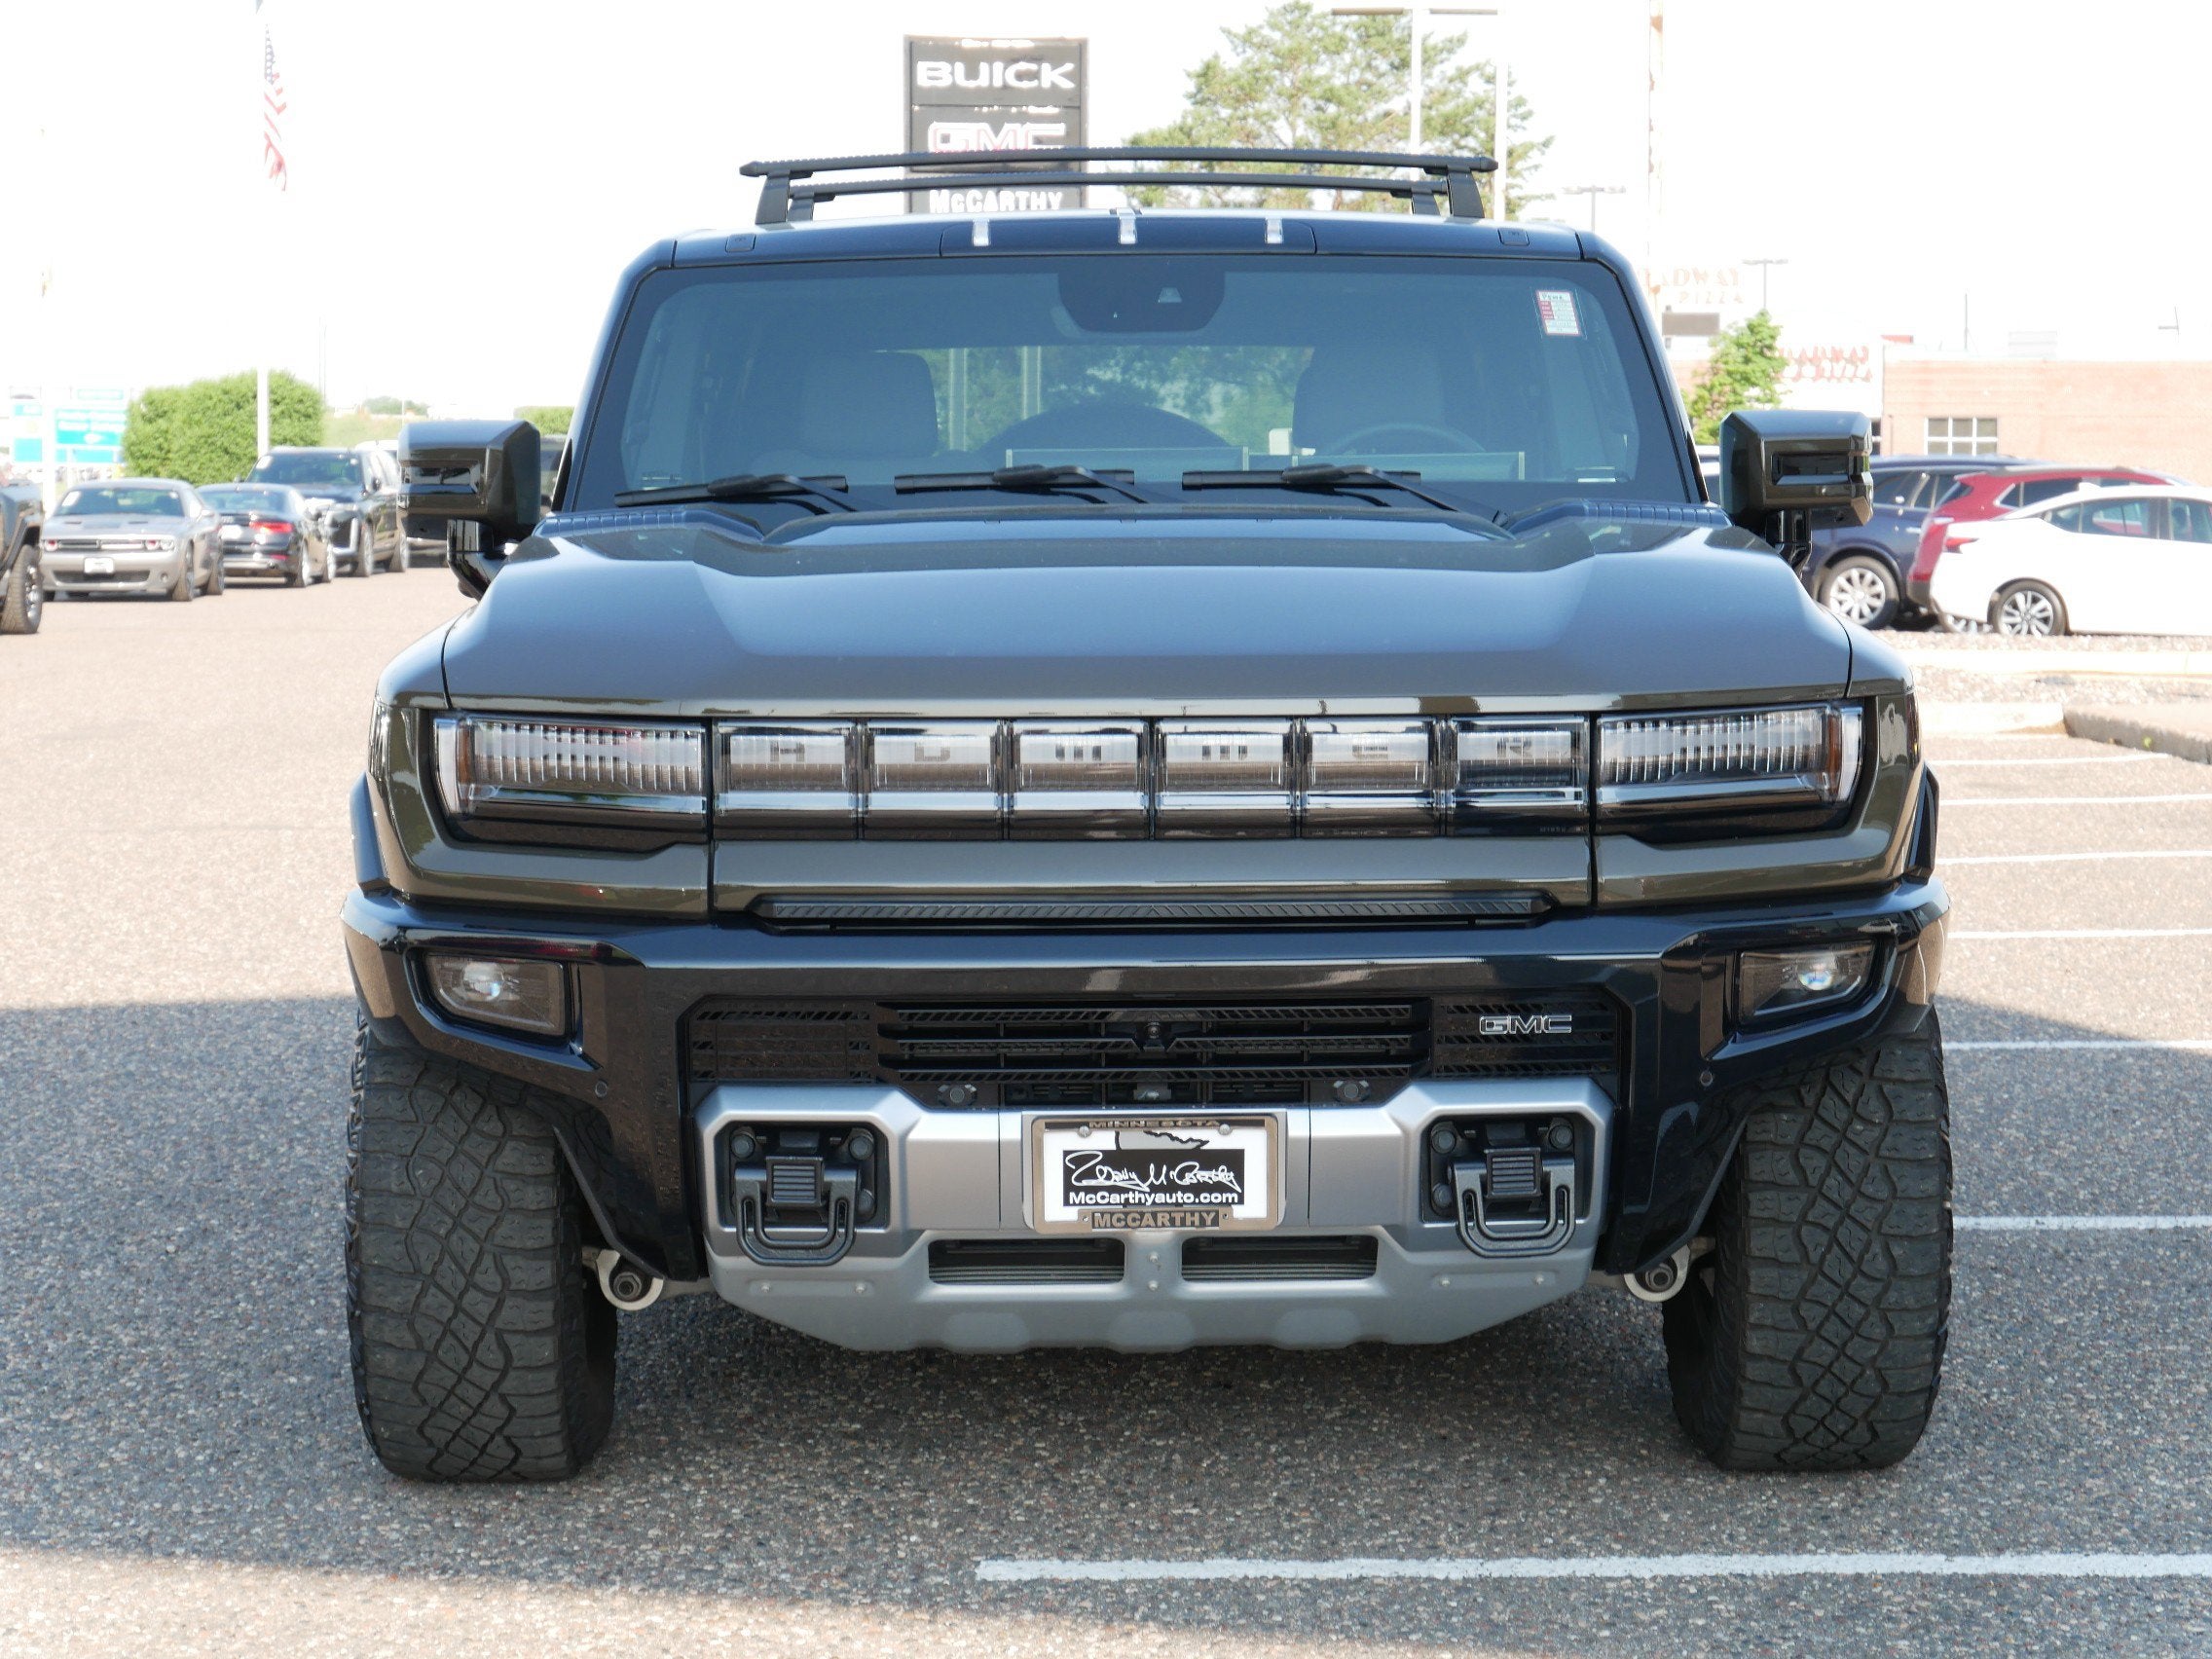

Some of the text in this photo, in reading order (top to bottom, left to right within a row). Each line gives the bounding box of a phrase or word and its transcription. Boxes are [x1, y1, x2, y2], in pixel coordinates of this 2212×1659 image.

[916, 60, 1075, 89] BUICK
[927, 121, 1066, 153] GMC
[929, 189, 1063, 213] McCARTHY
[1479, 1014, 1572, 1035] GMC
[1088, 1119, 1221, 1129] MINNESOTA
[1069, 1191, 1238, 1206] McCarthyauto.com
[1093, 1211, 1217, 1228] MCCARTHY
